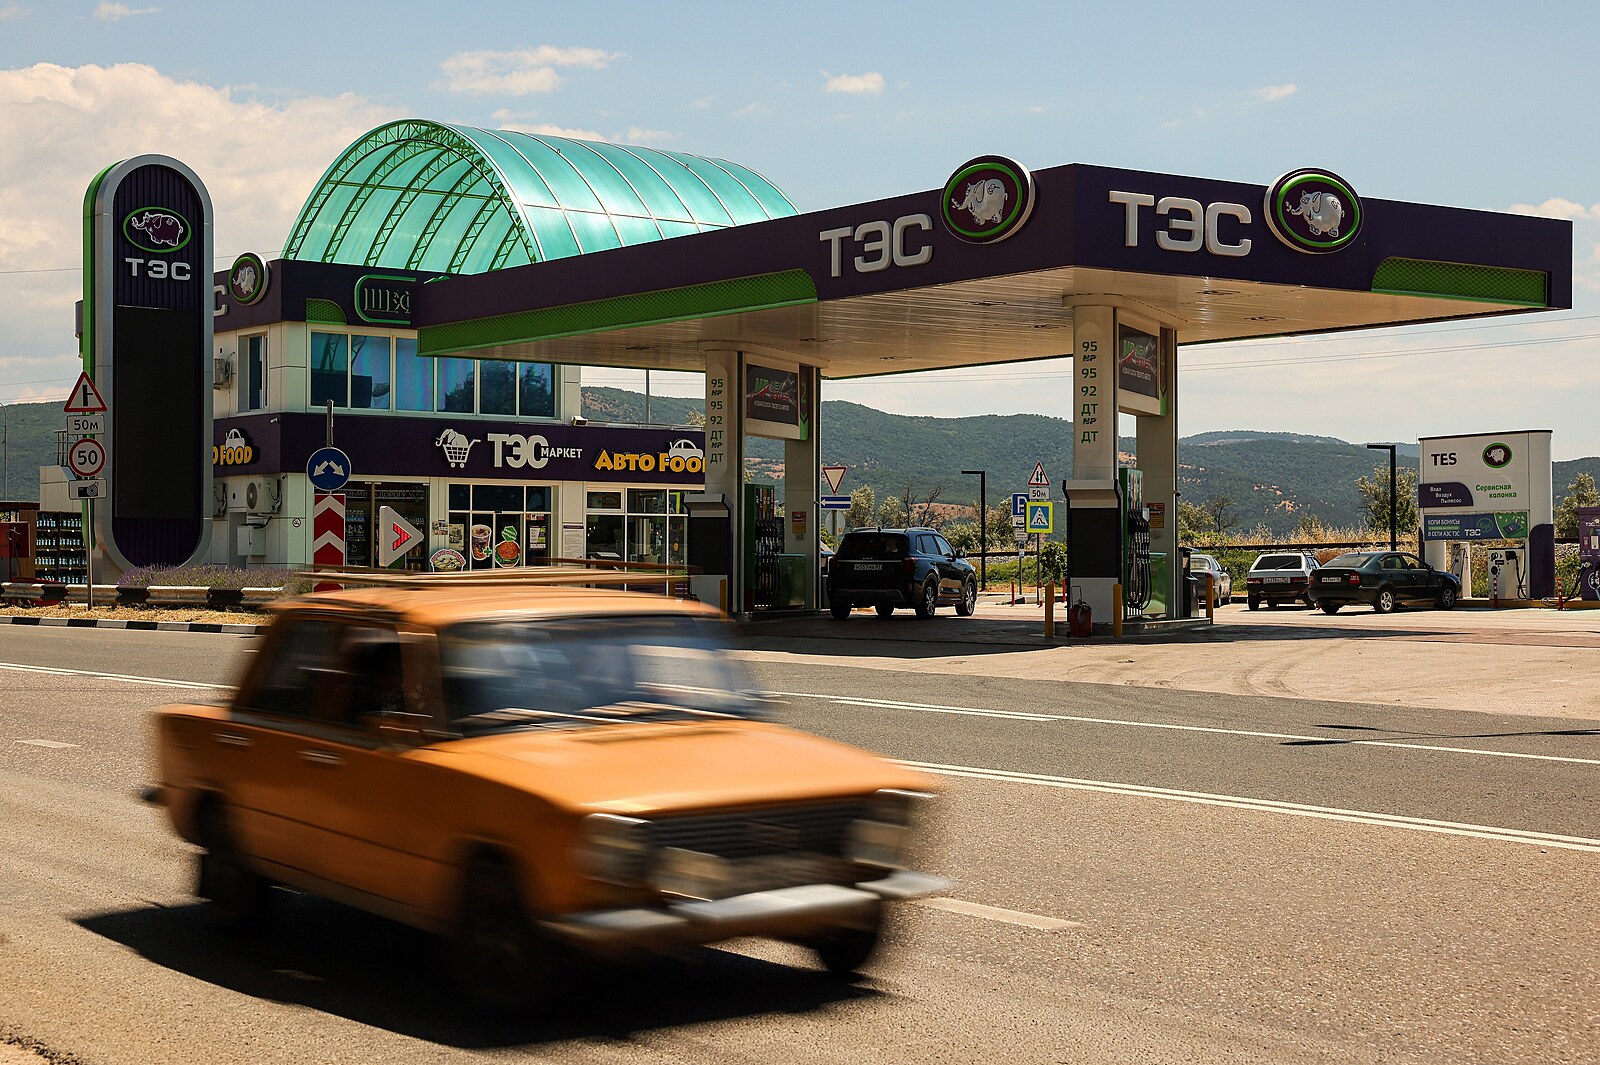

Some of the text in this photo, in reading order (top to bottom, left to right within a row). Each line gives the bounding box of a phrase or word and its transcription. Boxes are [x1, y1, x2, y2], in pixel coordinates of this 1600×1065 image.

[1108, 190, 1252, 257] ТЭС
[819, 213, 934, 278] ТЭС
[125, 257, 191, 281] ТЭС
[1082, 341, 1098, 352] 95
[1081, 368, 1097, 379] 95
[711, 379, 724, 388] 95
[1081, 385, 1097, 396] 92
[710, 401, 723, 410] 95
[1081, 403, 1098, 416] ДТ
[710, 416, 723, 425] 92
[710, 430, 724, 441] ДТ
[1081, 431, 1098, 444] ДТ
[487, 433, 583, 469] ТЭС МАРКЕТ
[77, 449, 98, 466] 50
[659, 452, 706, 473] FOO
[710, 453, 724, 464] ДТ
[1431, 452, 1457, 466] TES
[1475, 484, 1512, 493] Сервисная
[1464, 528, 1481, 537] ТЭС
